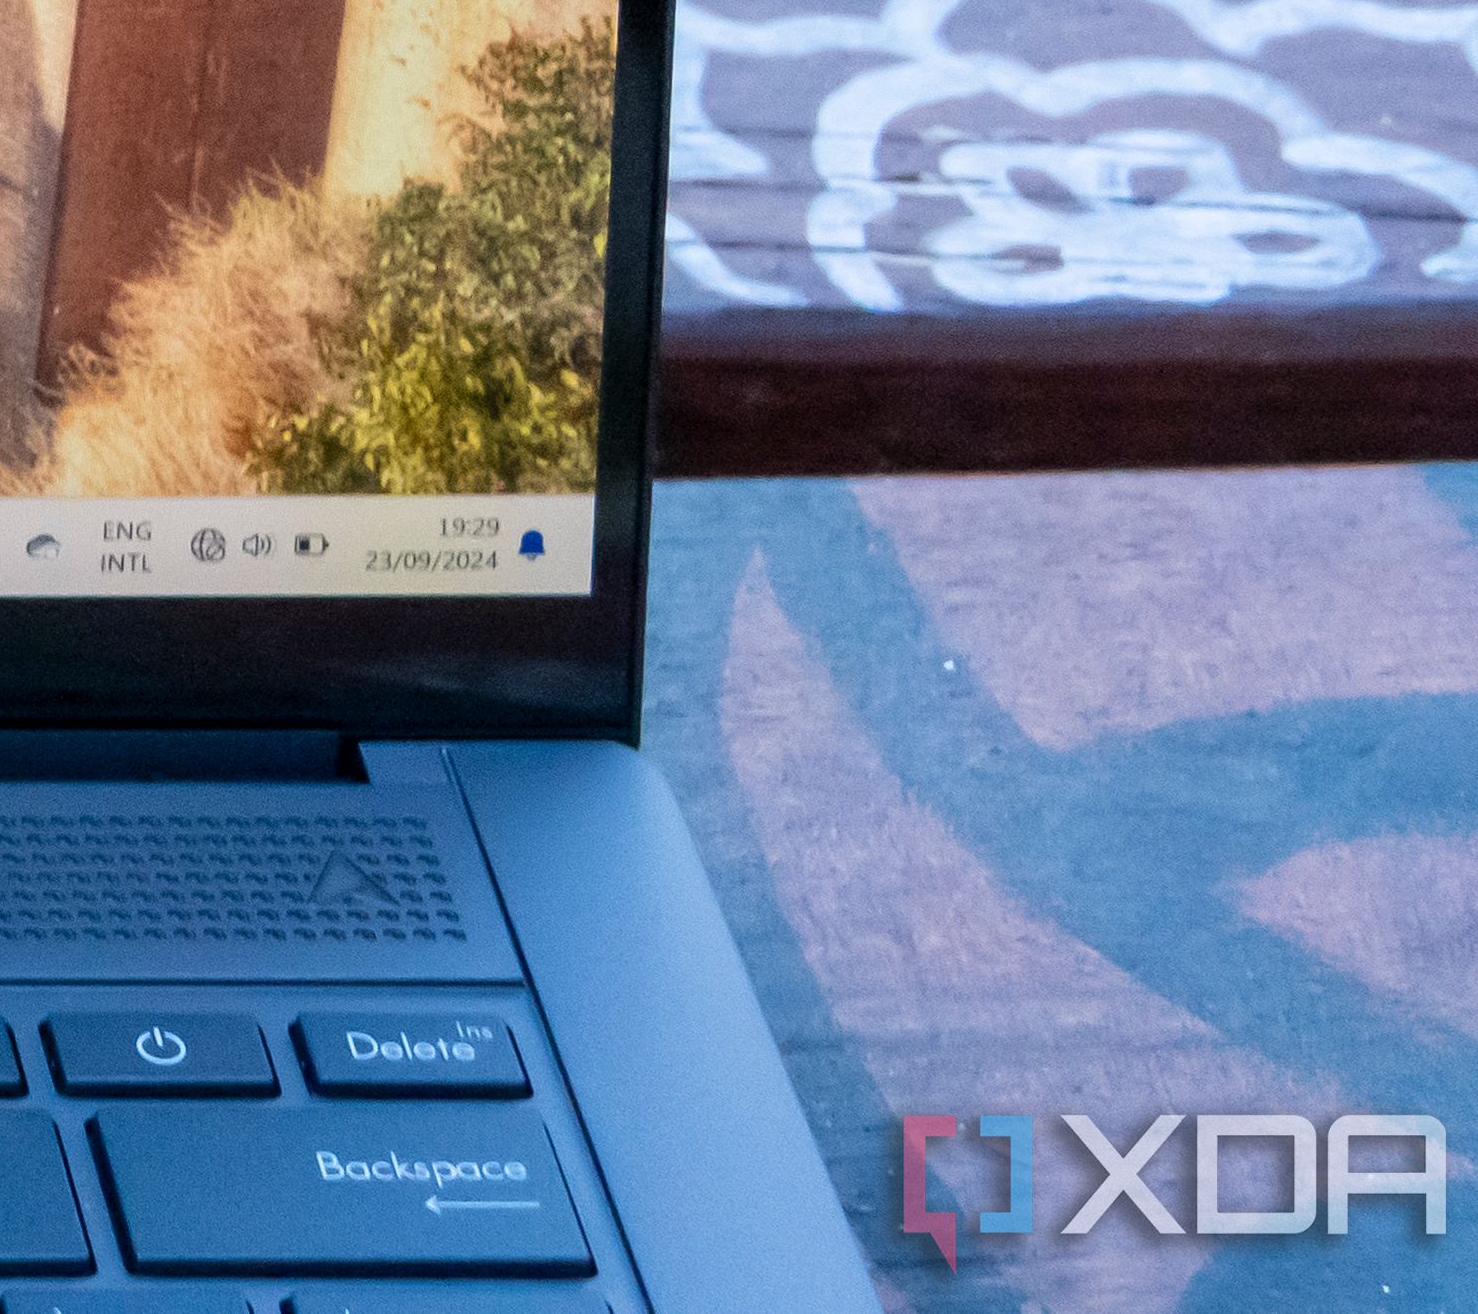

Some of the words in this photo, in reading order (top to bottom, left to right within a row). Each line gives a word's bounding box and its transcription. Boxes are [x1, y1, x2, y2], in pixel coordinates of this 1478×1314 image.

[102, 521, 152, 542] ENG
[439, 517, 501, 538] 19:29
[100, 553, 152, 573] INTL
[365, 550, 499, 572] 23/09/2024
[455, 1020, 494, 1040] Ins
[346, 1030, 476, 1062] Delete
[315, 1150, 528, 1189] Backspace
